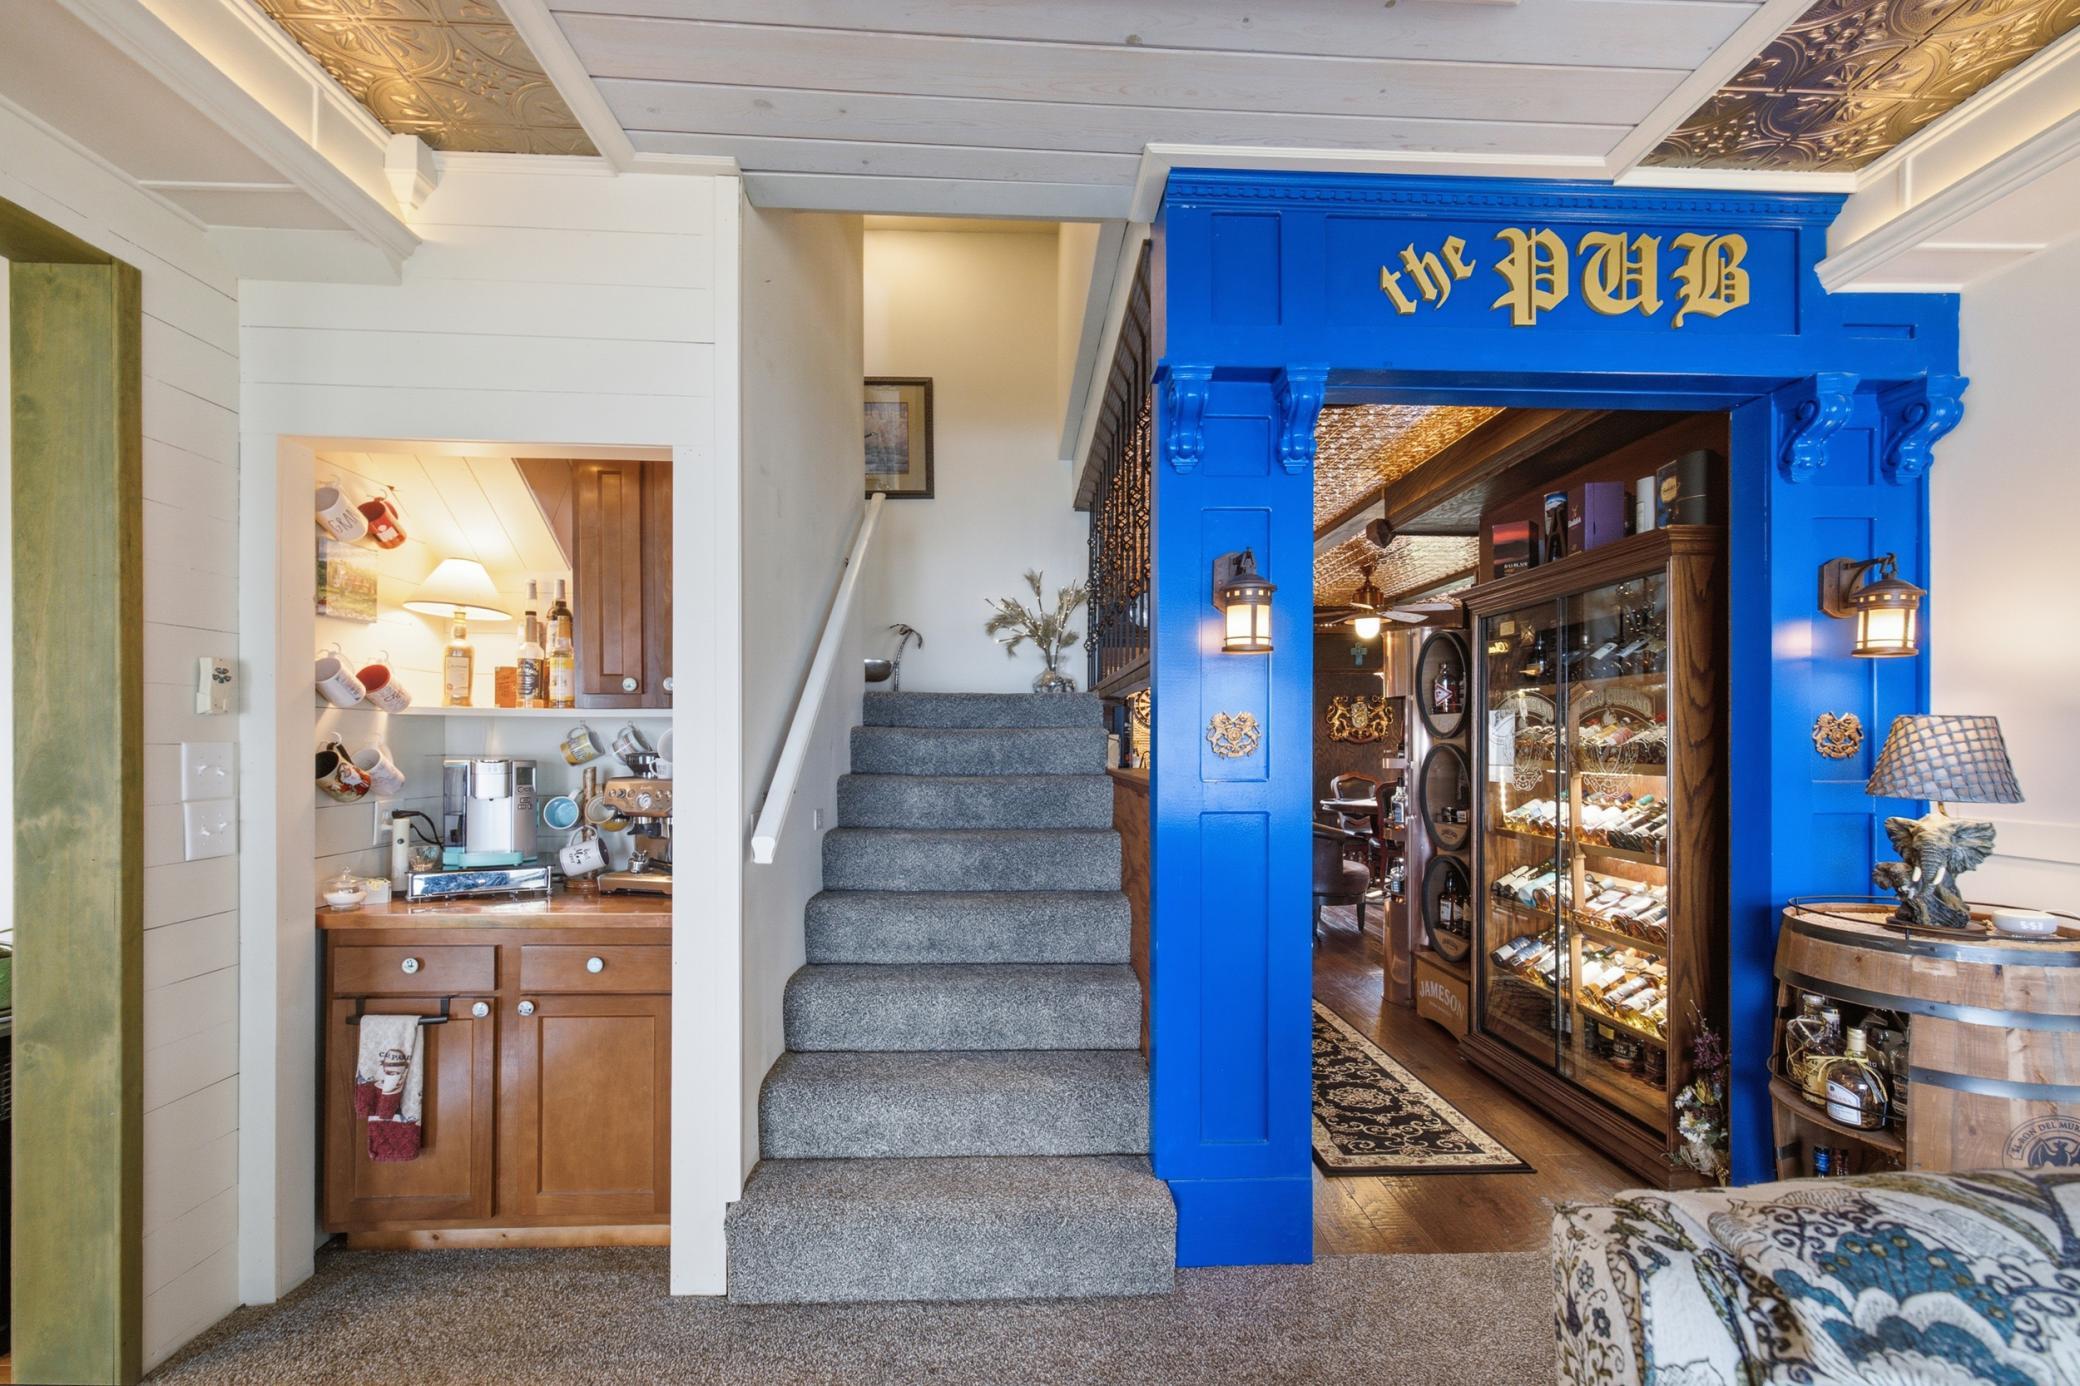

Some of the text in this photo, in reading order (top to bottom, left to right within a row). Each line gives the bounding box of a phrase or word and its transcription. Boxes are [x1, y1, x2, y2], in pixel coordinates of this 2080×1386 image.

[1379, 227, 1750, 328] the PUB
[1419, 980, 1465, 1021] JAMESON
[2038, 1121, 2057, 1132] DEL
